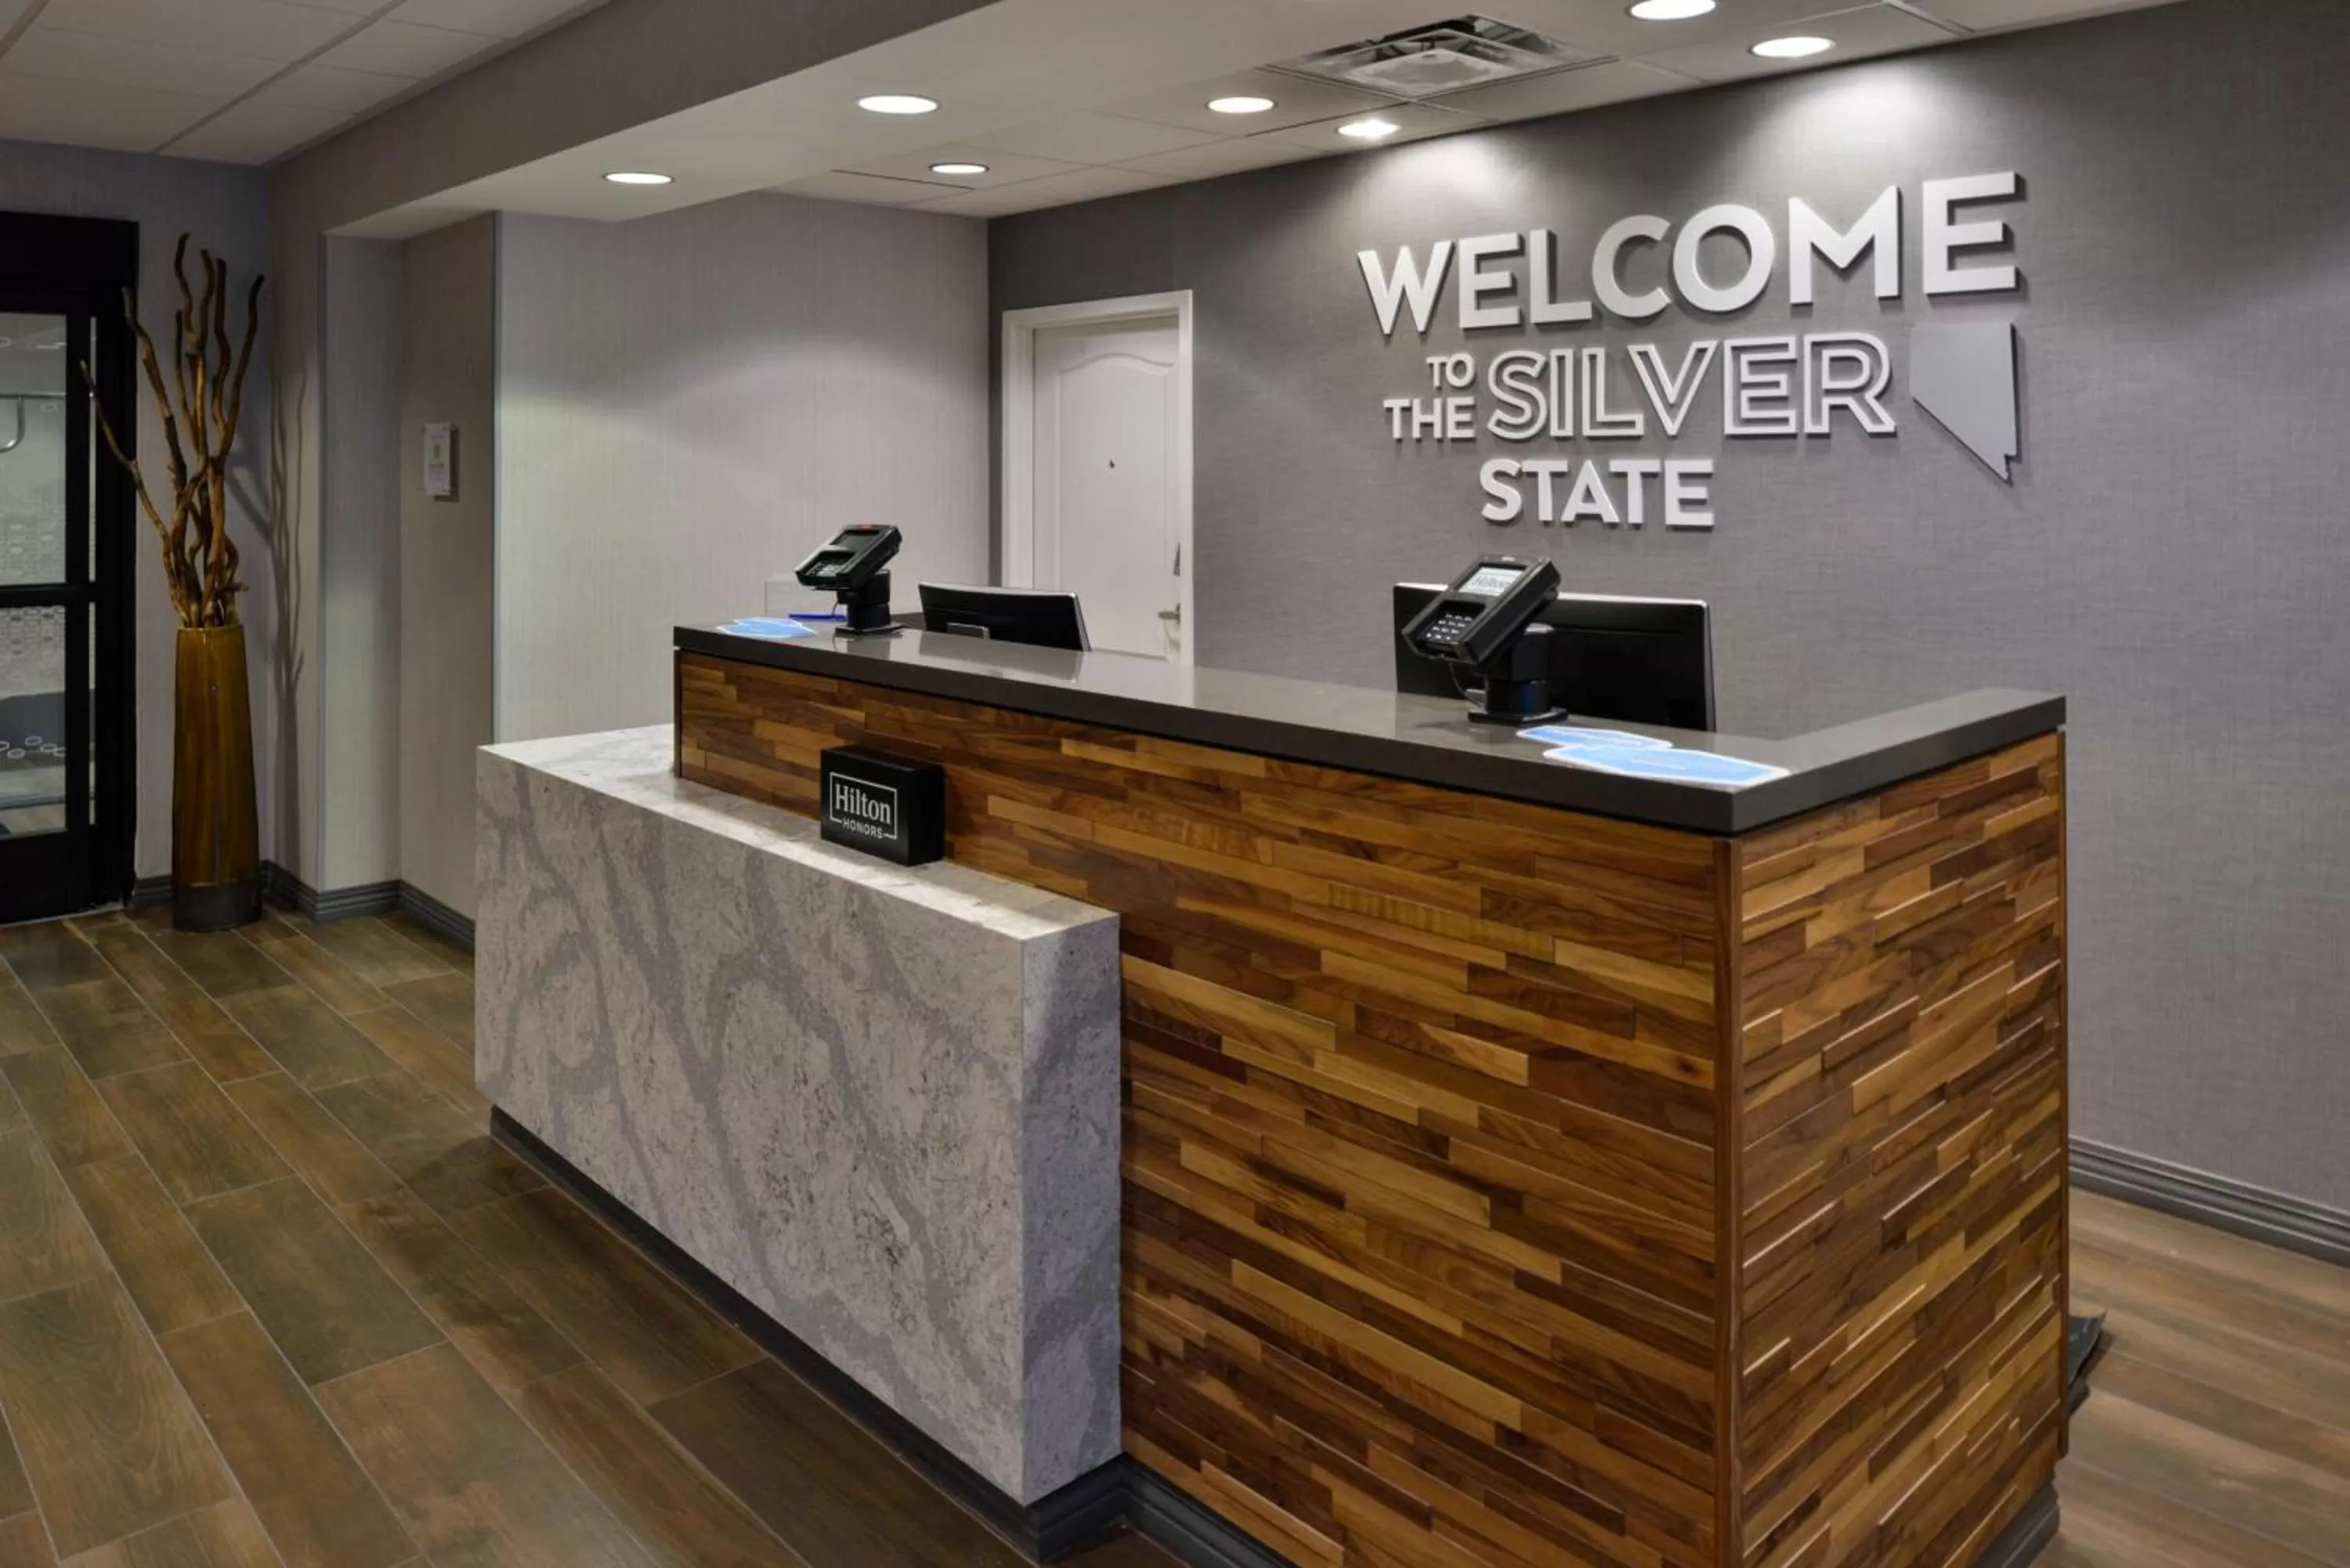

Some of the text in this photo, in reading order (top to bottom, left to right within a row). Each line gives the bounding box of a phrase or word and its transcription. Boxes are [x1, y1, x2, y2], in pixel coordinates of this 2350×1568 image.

[1358, 172, 2018, 335] WELCOME
[1383, 332, 1897, 441] THE SILVER
[1426, 353, 1476, 389] TO
[1480, 458, 1716, 528] STATE
[835, 783, 891, 825] Hilton
[843, 818, 883, 839] HONORS
